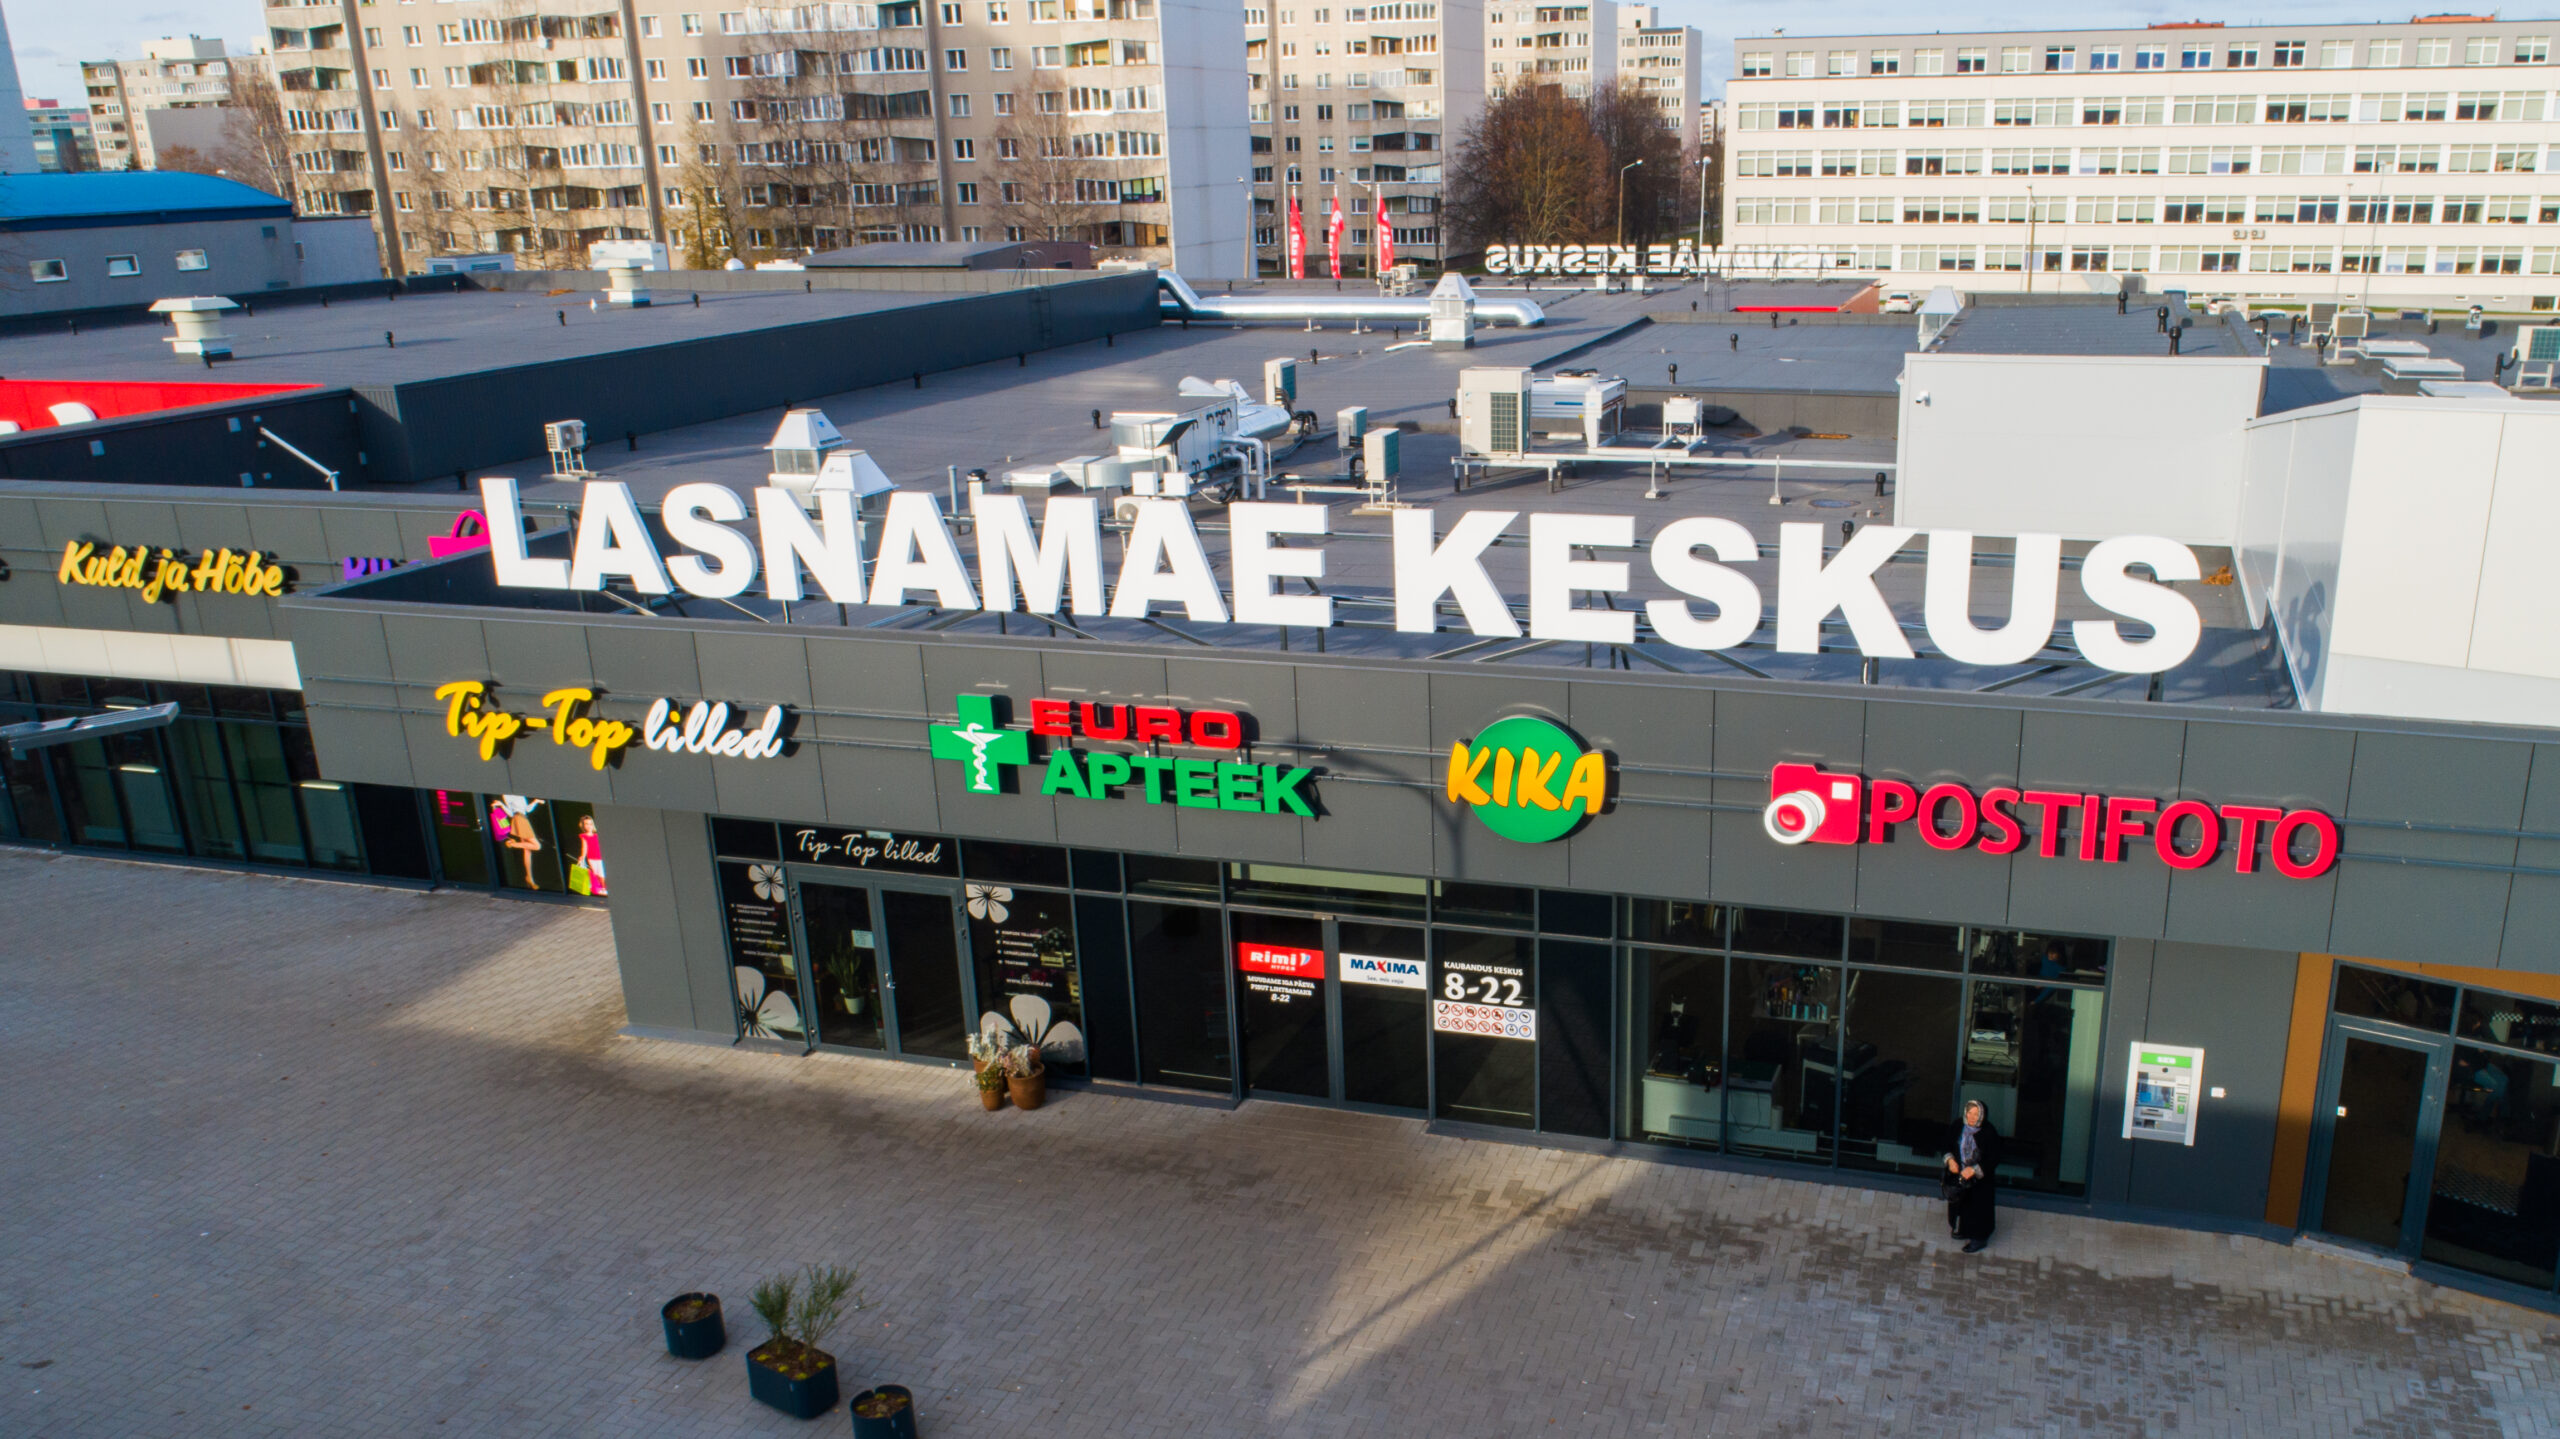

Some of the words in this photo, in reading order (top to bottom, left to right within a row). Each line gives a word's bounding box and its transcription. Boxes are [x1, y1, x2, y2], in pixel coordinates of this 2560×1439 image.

[59, 540, 148, 588] Kuld
[143, 548, 189, 604] ja
[191, 547, 284, 597] Hõbe
[480, 470, 1334, 627] LASNAMÄE
[1392, 508, 2203, 674] KESKUS
[435, 680, 634, 771] Tip-Top
[644, 697, 784, 760] lilled
[1031, 699, 1242, 750] EURO
[1041, 748, 1317, 818] APTEEK
[1447, 741, 1606, 816] KIKA
[796, 829, 878, 866] Tip-Top
[884, 838, 941, 864] lilled
[1868, 778, 2338, 880] POSTIFOTO
[1350, 958, 1419, 975] MAXIMA
[1444, 961, 1493, 973] KAUBANDUS
[1494, 966, 1524, 976] KESKUS
[1444, 972, 1524, 1007] 8-22
[1271, 993, 1291, 1003] 8-22
